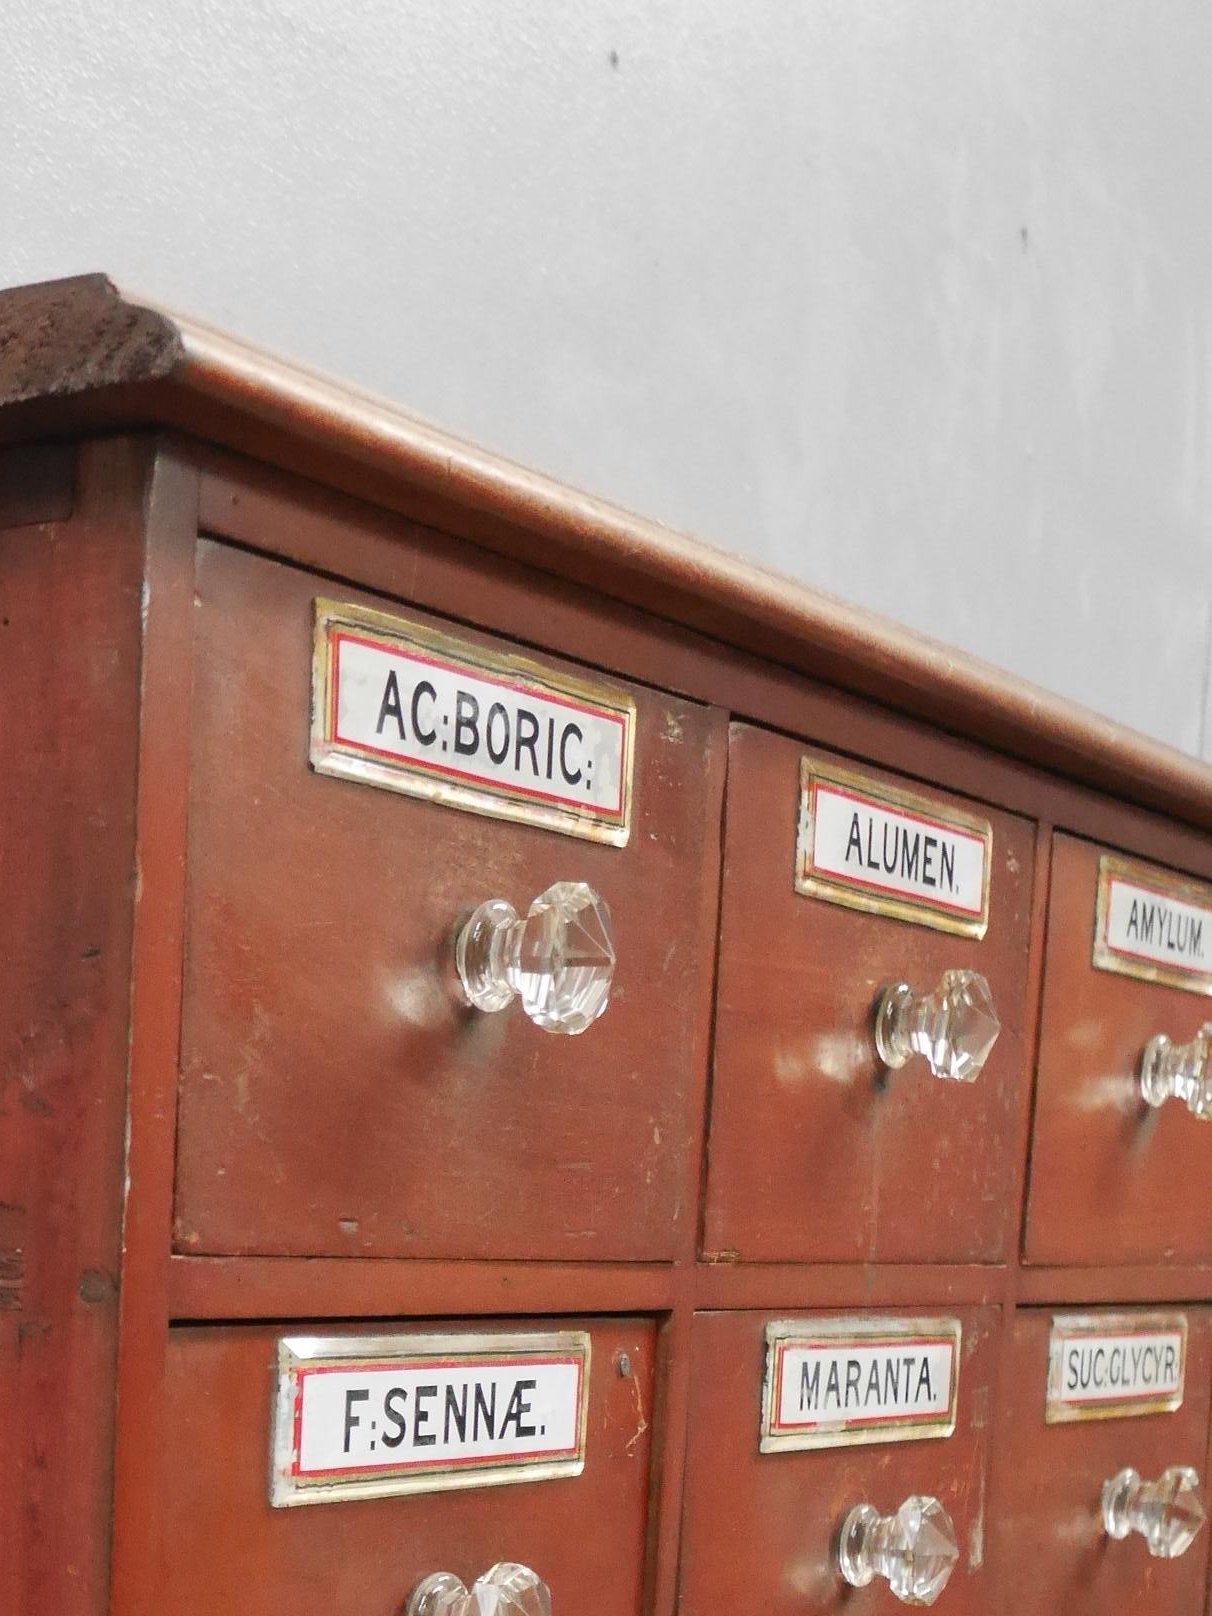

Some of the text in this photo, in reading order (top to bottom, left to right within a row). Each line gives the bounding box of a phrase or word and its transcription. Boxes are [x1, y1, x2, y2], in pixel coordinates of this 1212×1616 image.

[376, 670, 593, 790] AC:BORIC:
[845, 812, 959, 894] ALUMEN.
[1126, 899, 1205, 958] AMYLUM.
[343, 1379, 546, 1453] F:SENNÆ.
[799, 1356, 937, 1411] MARANTA.
